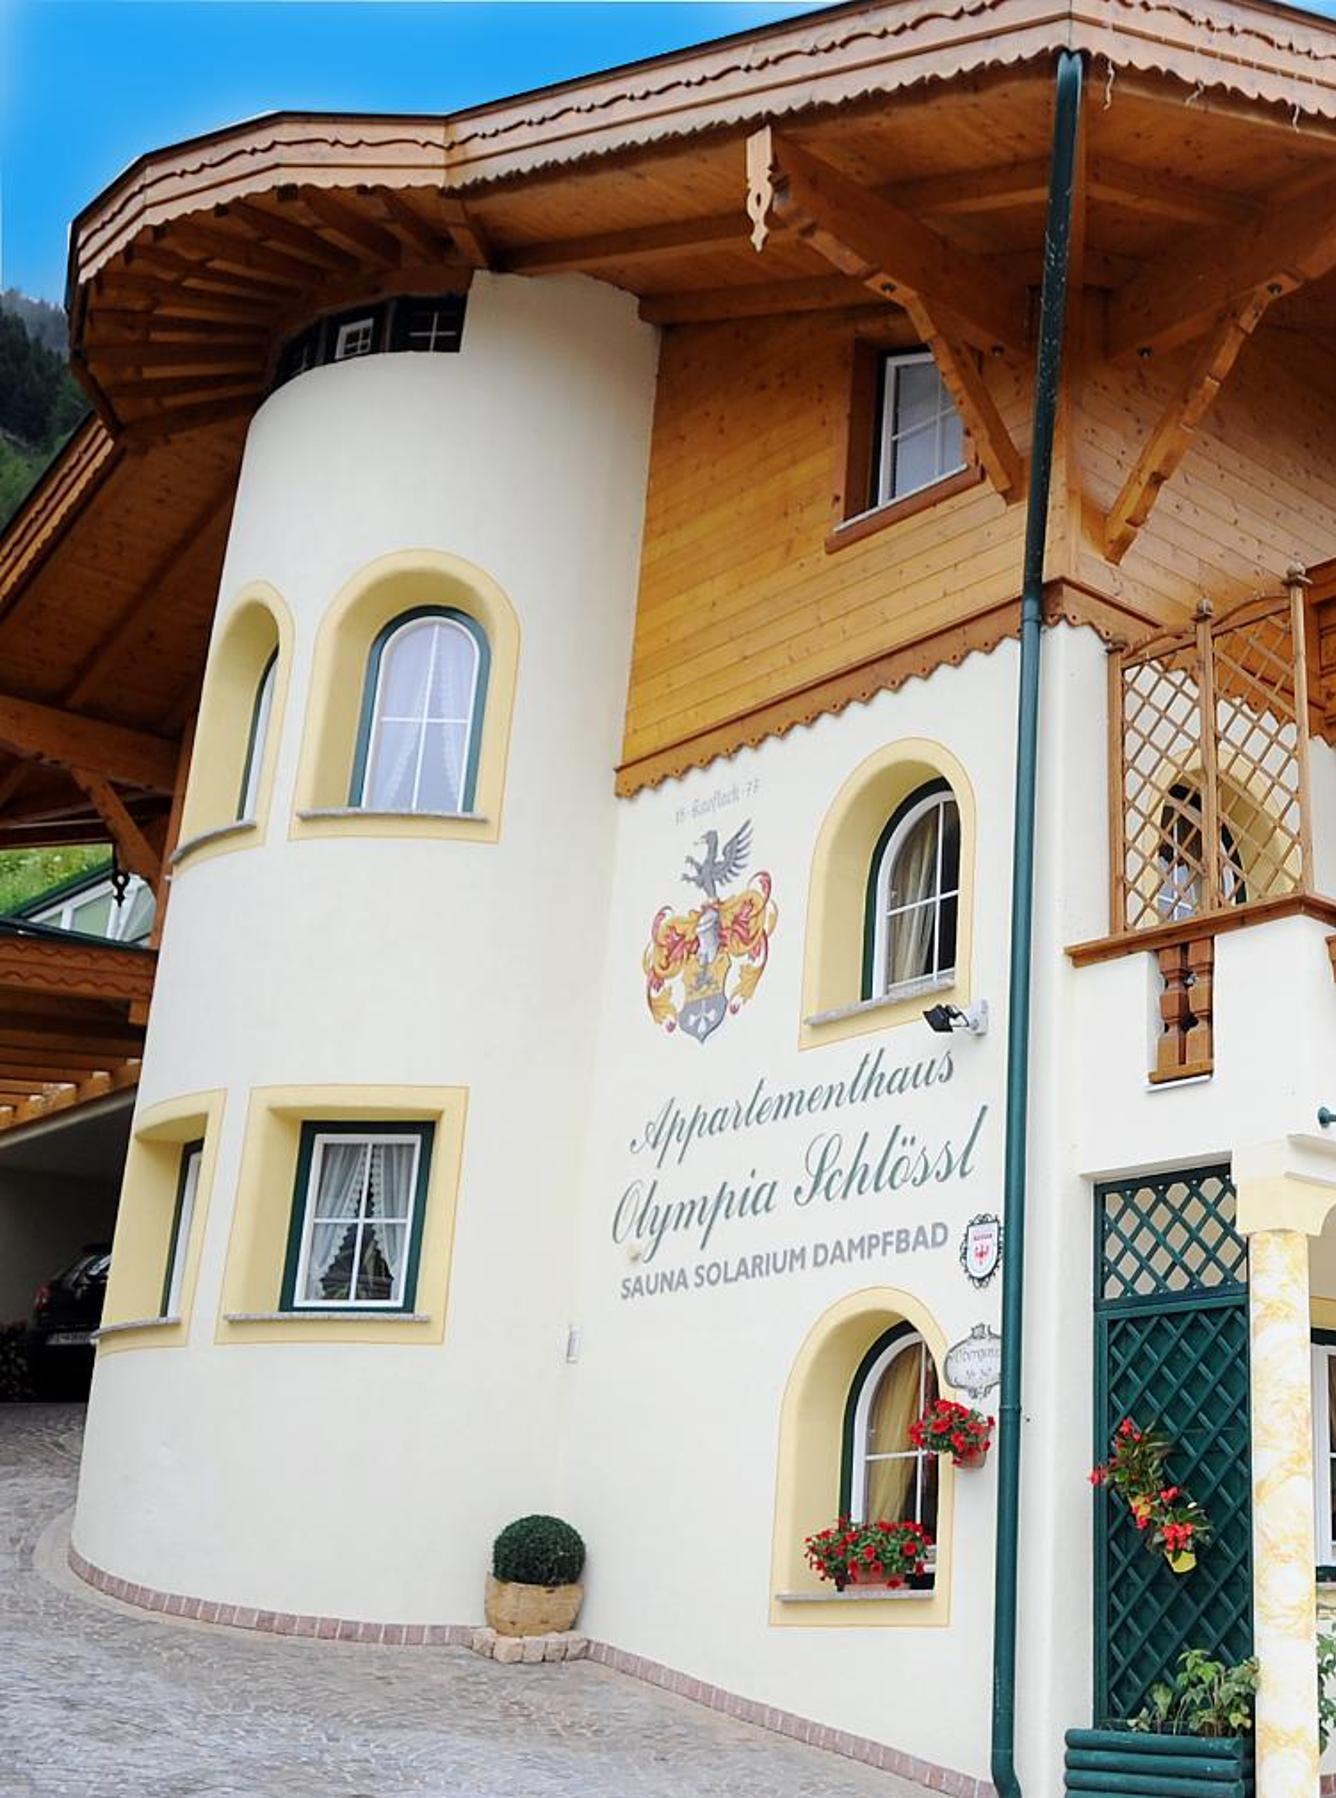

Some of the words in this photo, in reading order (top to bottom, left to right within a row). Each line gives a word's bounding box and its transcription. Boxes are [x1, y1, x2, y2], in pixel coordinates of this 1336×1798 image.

[629, 1048, 953, 1169] Appartementhaus
[612, 1168, 778, 1264] Olympia
[794, 1105, 989, 1206] Schlössl
[620, 1268, 689, 1300] SAUNA
[693, 1246, 806, 1288] SOLARIUM
[812, 1222, 949, 1268] DAMPFBAD
